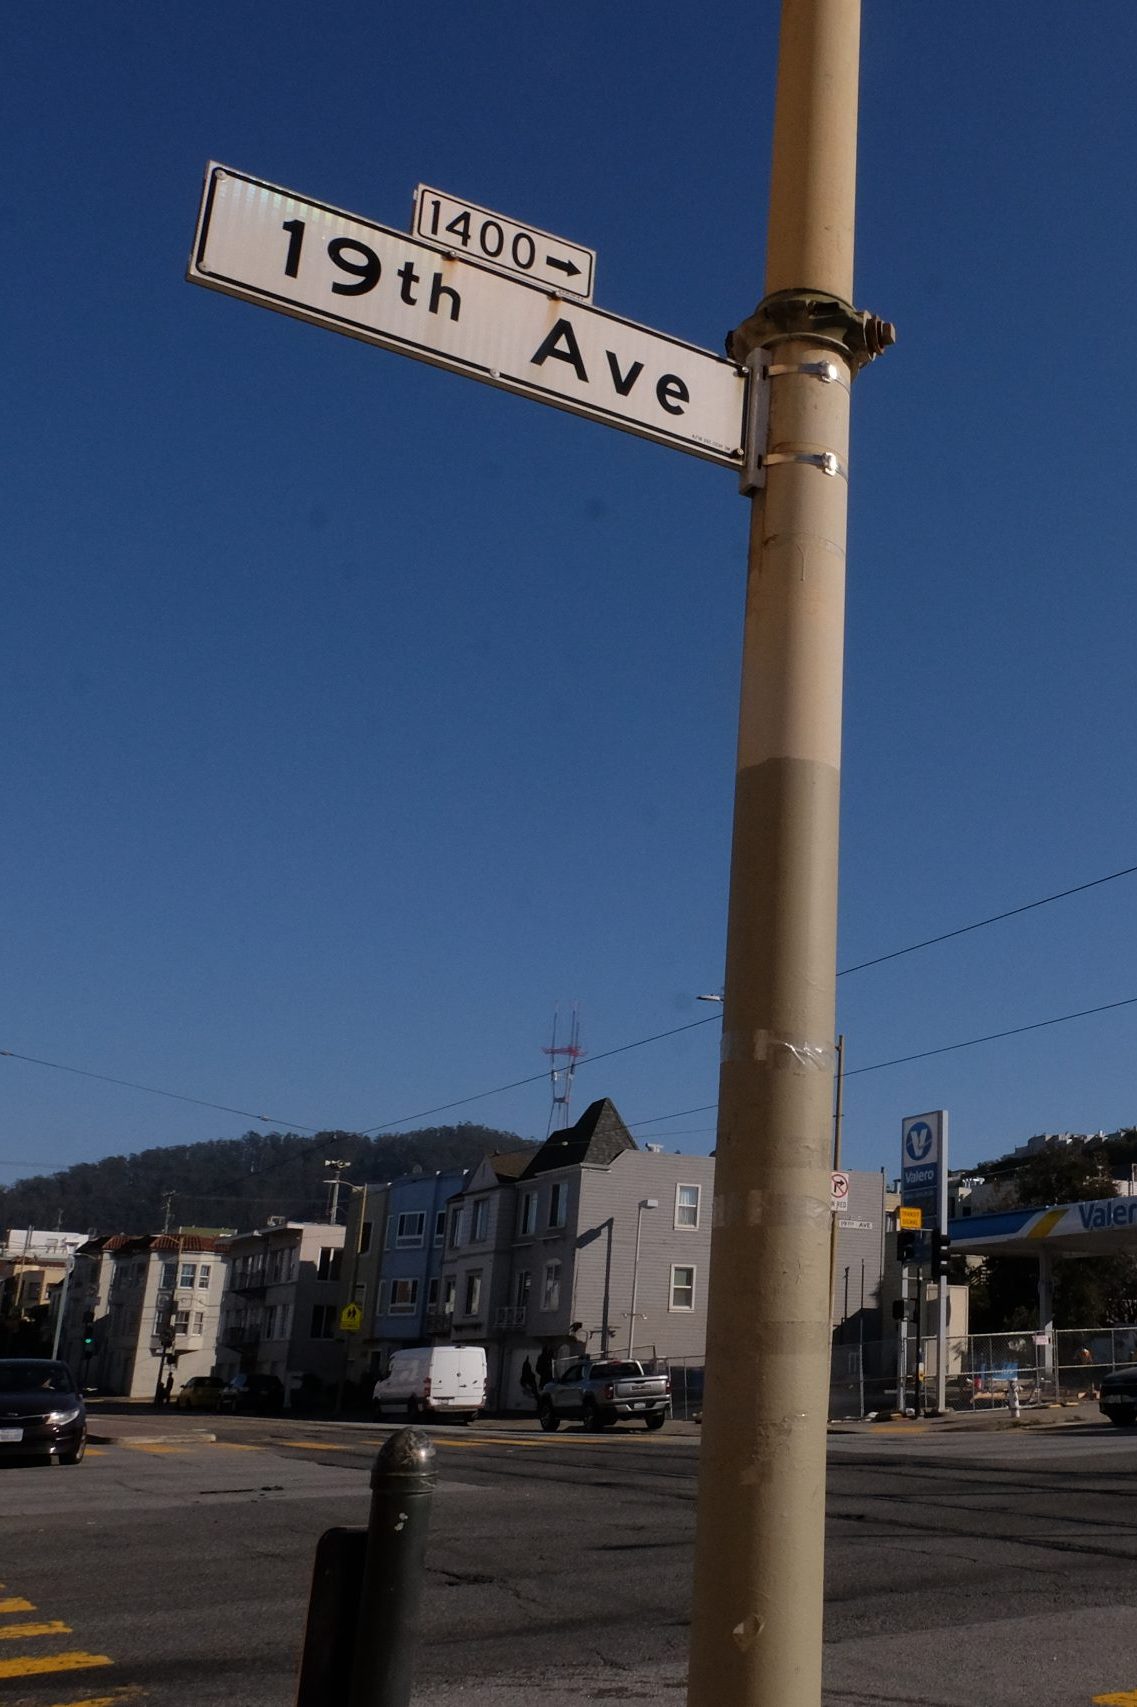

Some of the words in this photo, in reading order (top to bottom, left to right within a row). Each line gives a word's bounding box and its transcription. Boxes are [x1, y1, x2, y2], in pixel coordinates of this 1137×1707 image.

[431, 200, 536, 269] 1400
[282, 219, 461, 322] 19th
[530, 318, 691, 416] Ave
[905, 1168, 935, 1184] Valero
